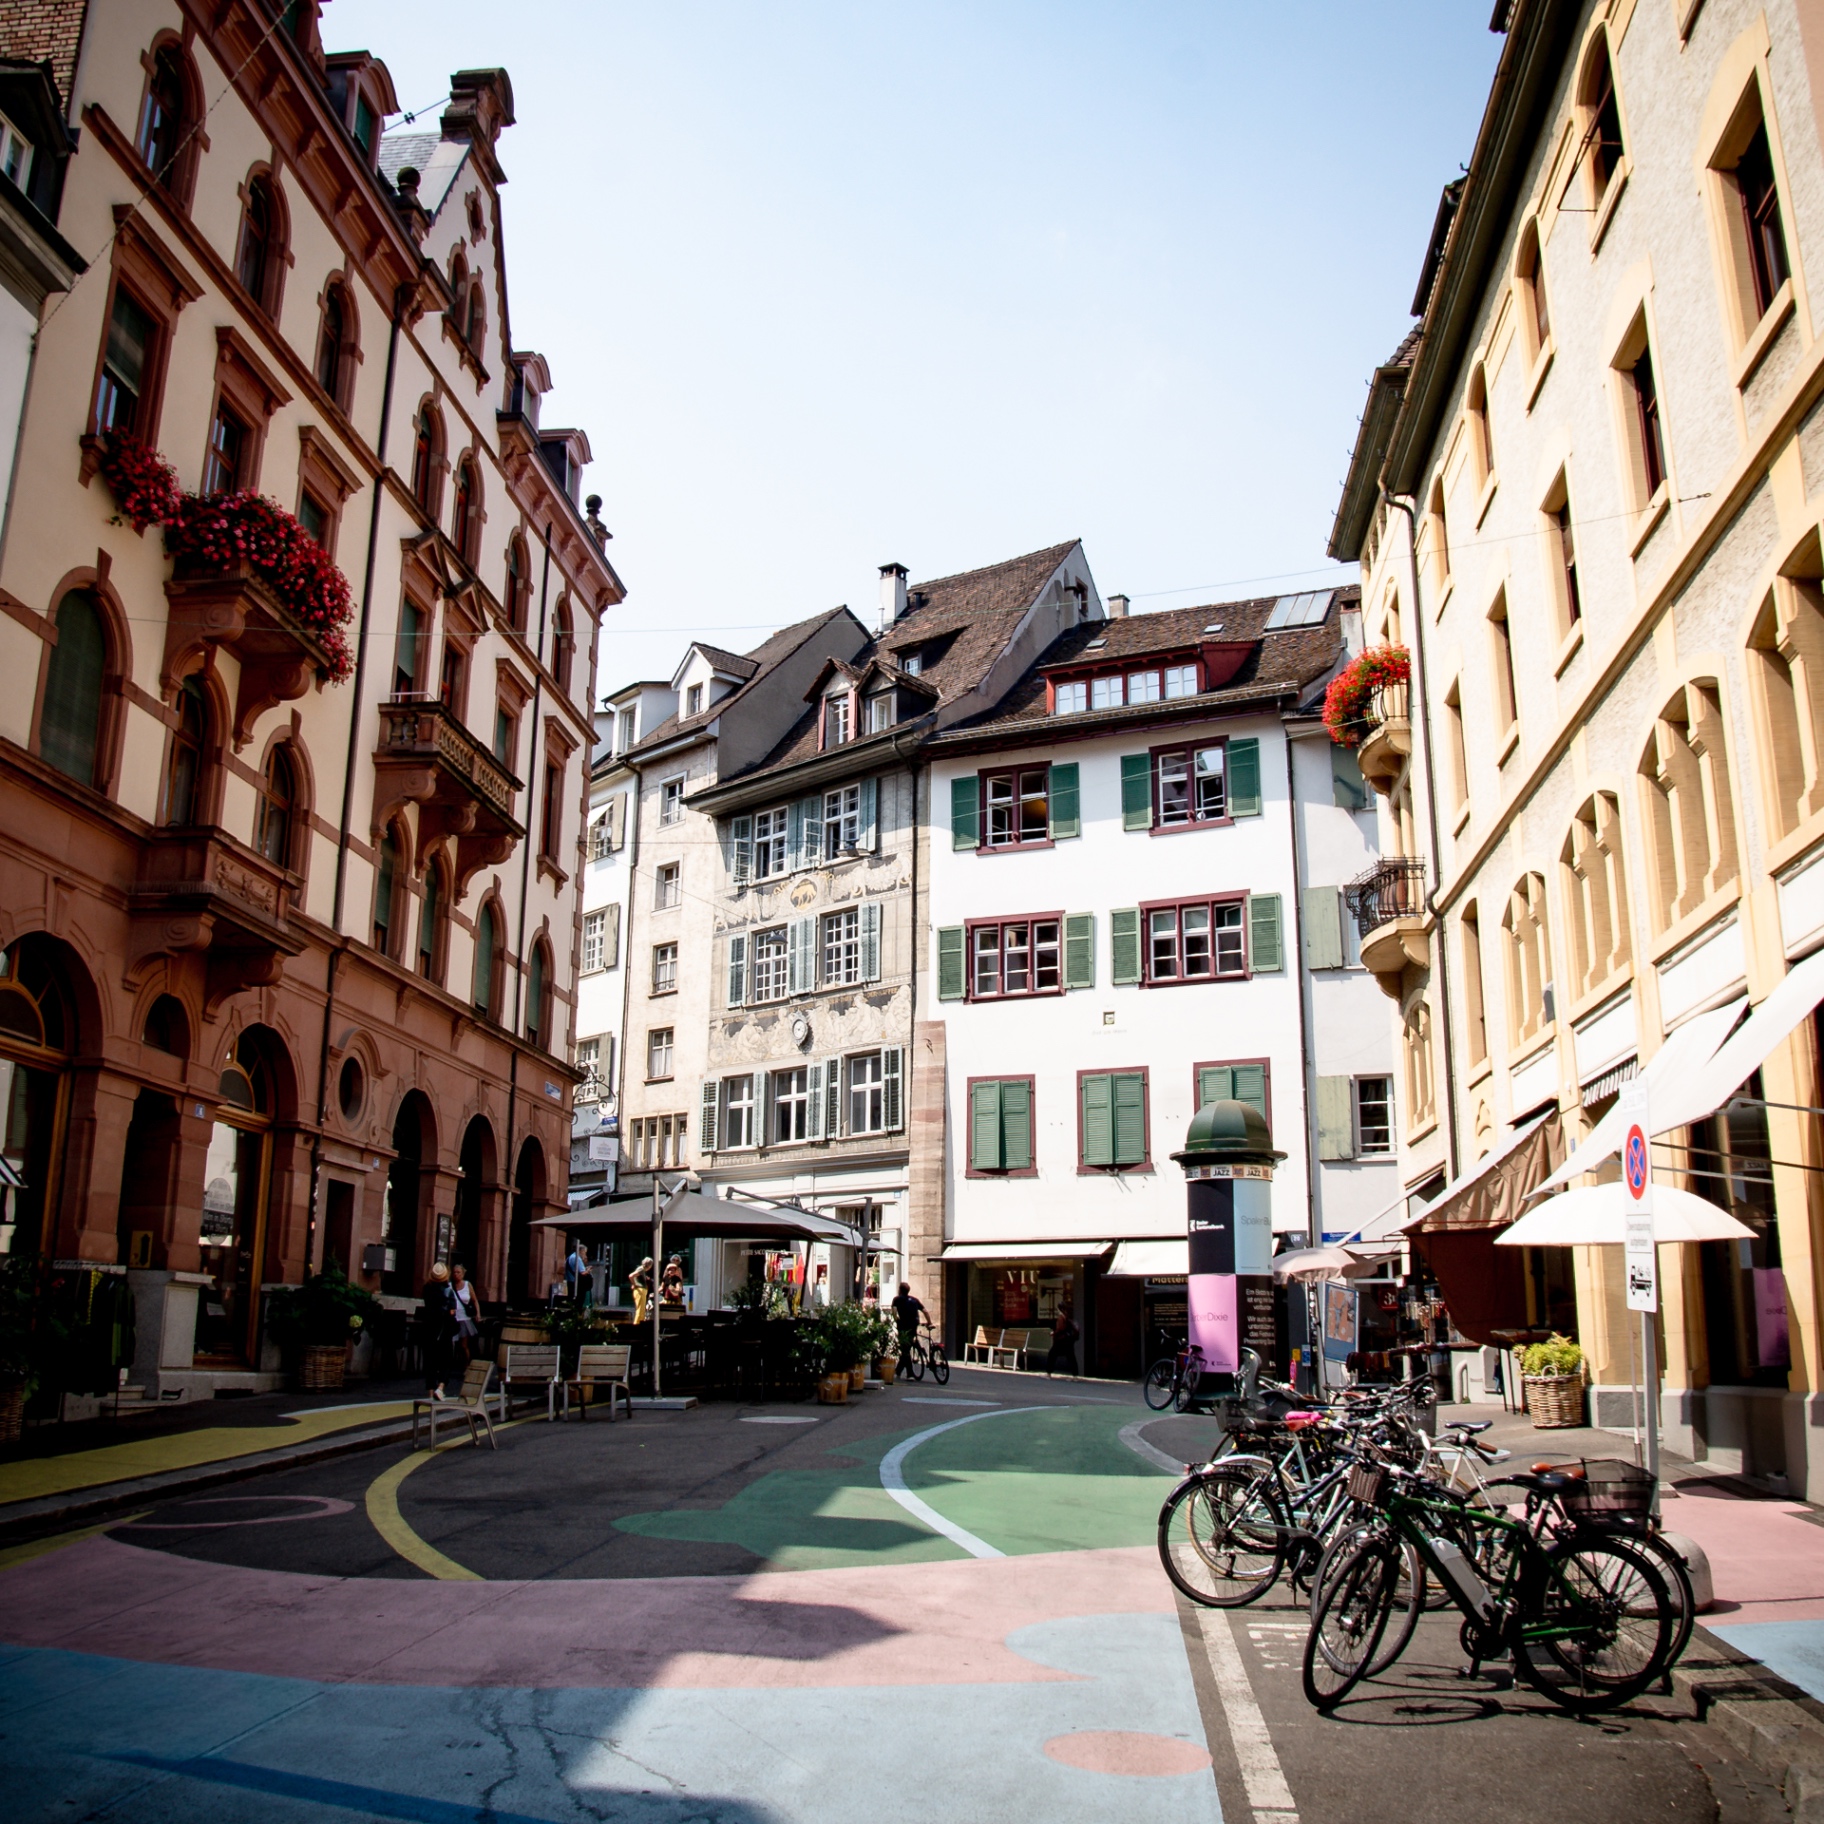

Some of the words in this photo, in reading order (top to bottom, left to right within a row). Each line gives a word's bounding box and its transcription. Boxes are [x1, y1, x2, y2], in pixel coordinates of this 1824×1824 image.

[1213, 1169, 1230, 1177] JAZZ
[1247, 1169, 1261, 1177] JAZZ
[1006, 1270, 1041, 1285] VIU
